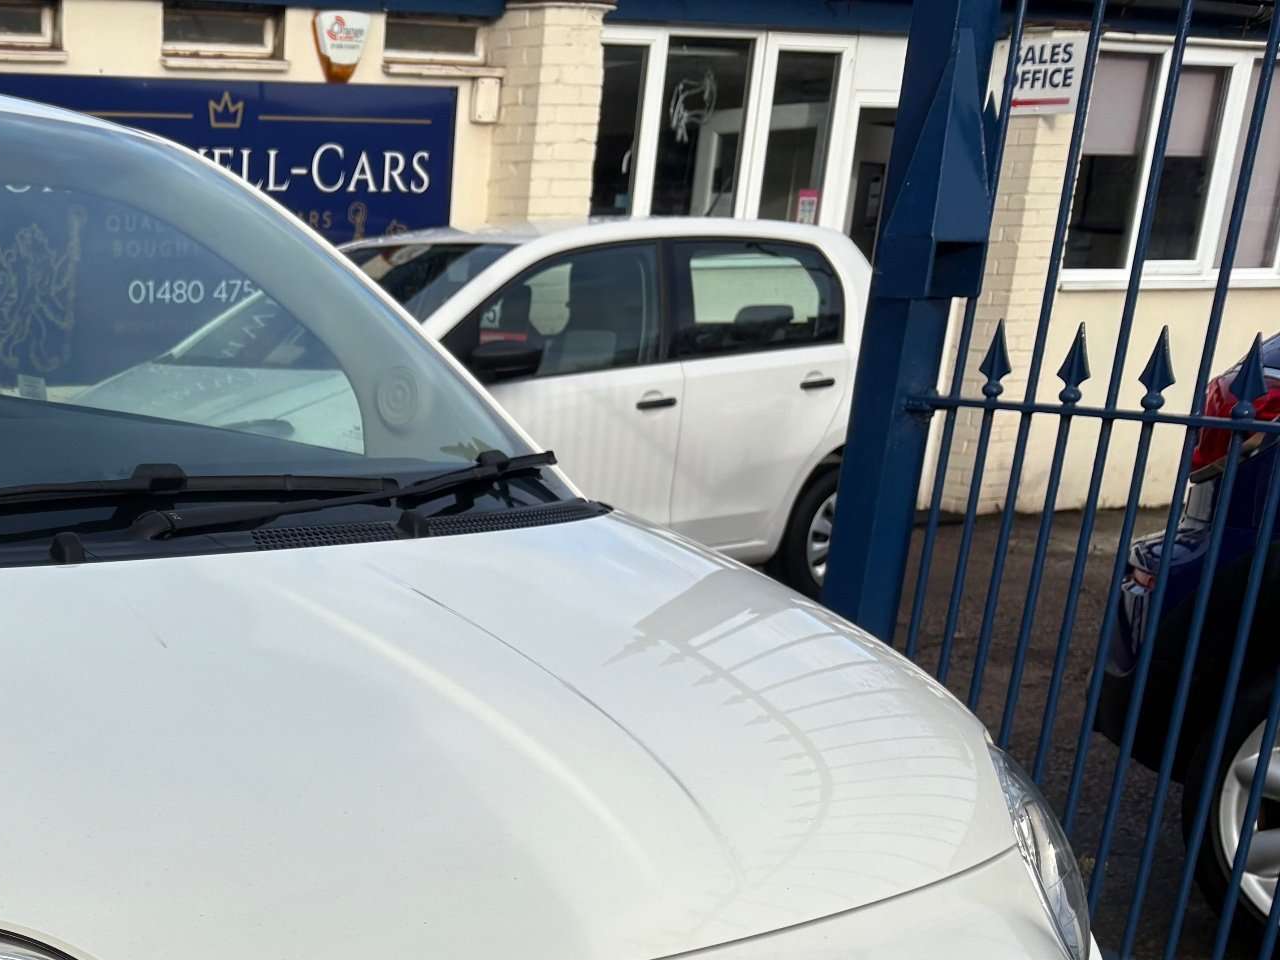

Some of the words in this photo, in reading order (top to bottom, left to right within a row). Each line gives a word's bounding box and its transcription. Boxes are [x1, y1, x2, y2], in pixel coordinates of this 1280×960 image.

[1018, 43, 1073, 65] ALES
[1013, 67, 1073, 88] FFICE
[128, 279, 205, 304] 01480
[213, 279, 256, 303] 475
